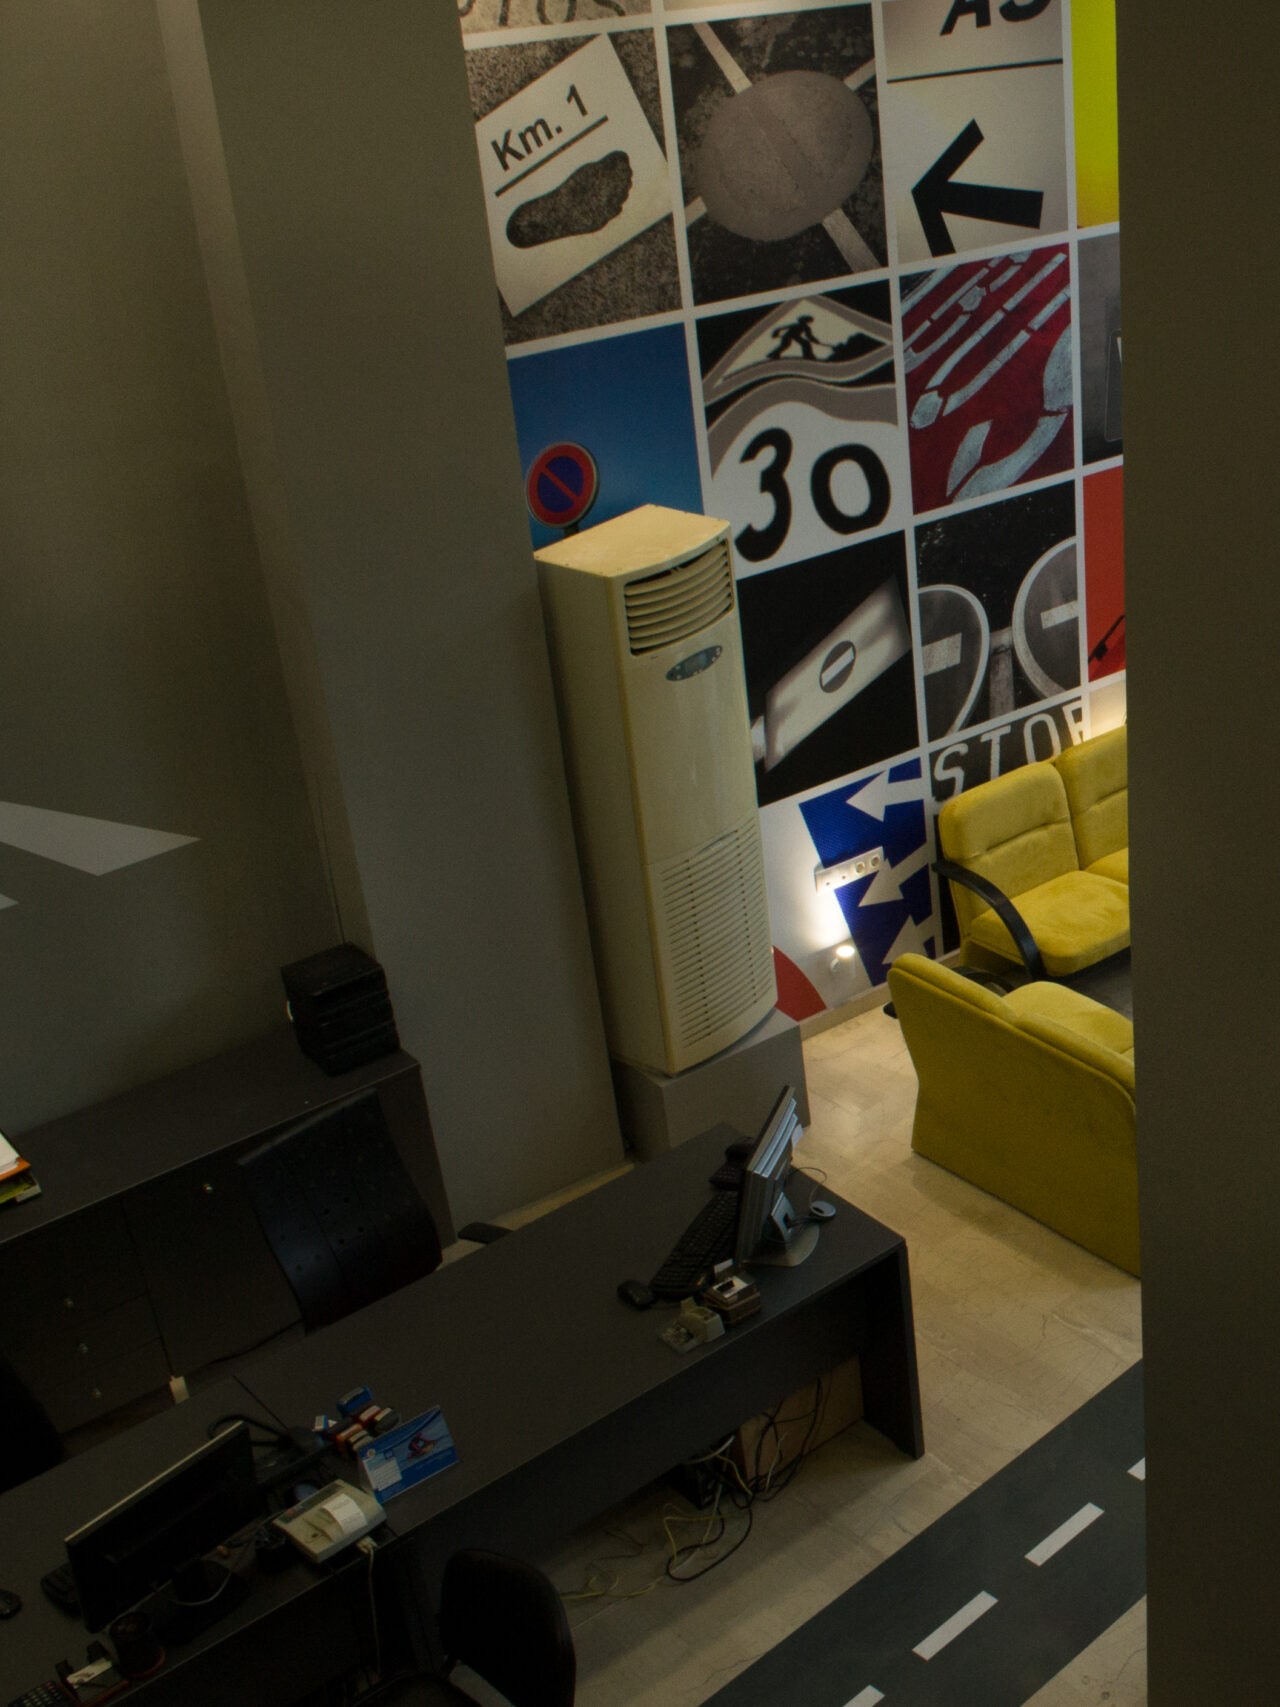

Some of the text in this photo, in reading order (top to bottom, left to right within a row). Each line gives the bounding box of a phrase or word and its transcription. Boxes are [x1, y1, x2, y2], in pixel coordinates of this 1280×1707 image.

[490, 83, 588, 172] Km. 1
[735, 427, 891, 563] 30
